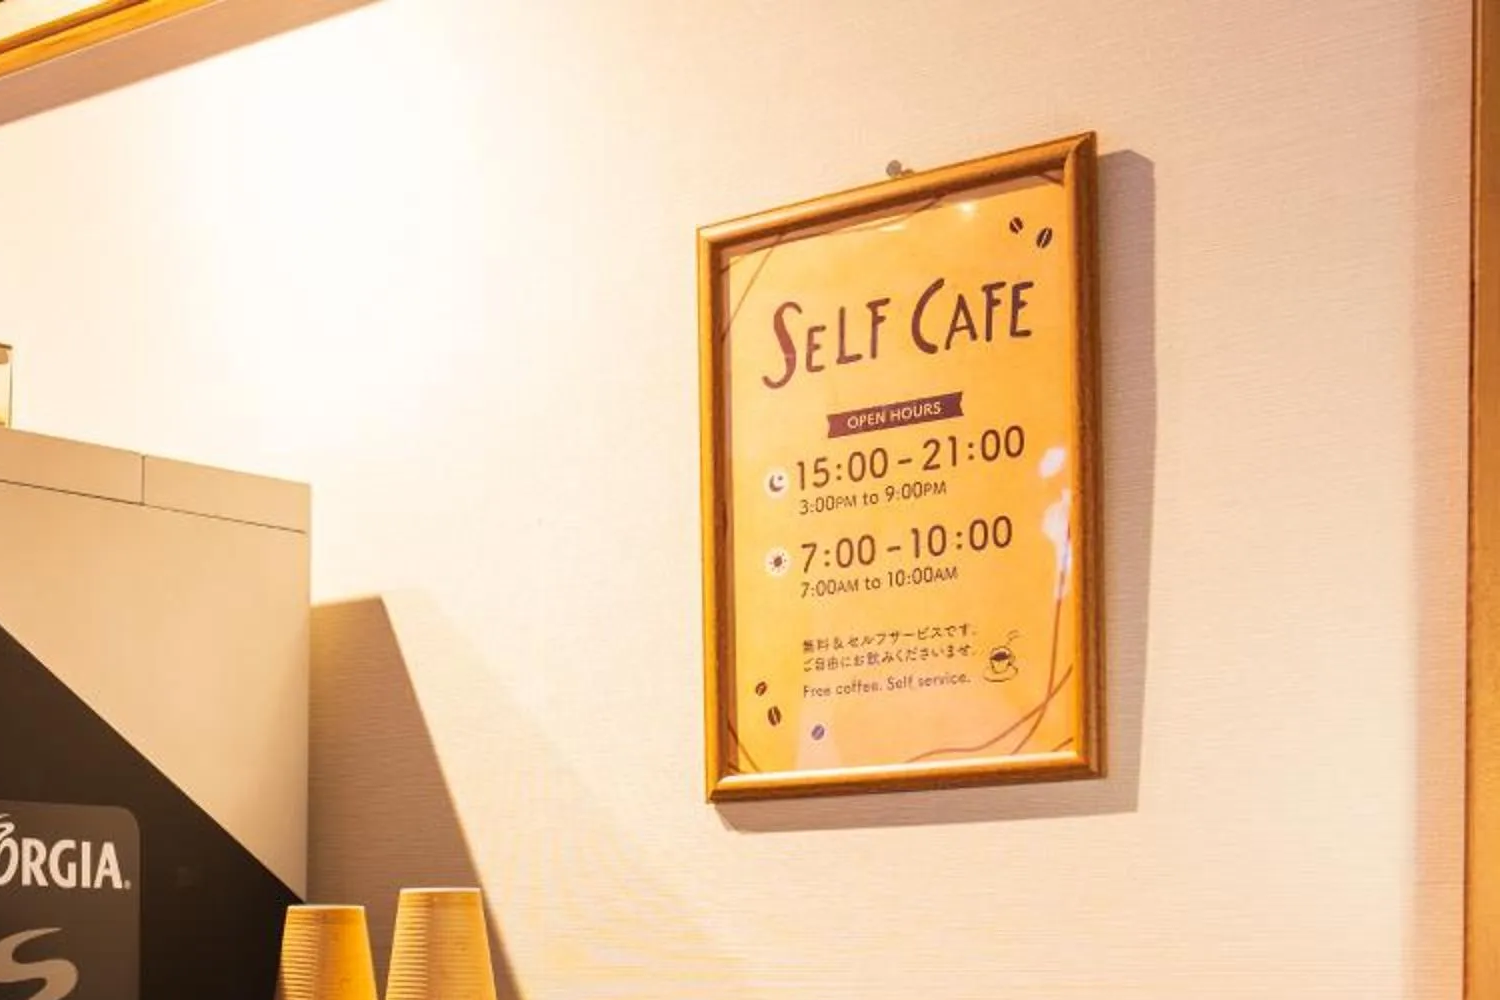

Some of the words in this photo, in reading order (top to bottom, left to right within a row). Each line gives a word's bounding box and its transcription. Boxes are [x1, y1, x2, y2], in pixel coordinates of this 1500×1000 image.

[762, 298, 891, 389] SELF
[911, 277, 1035, 354] CAFE
[847, 412, 886, 430] OPEN
[891, 401, 942, 422] HOURS
[799, 494, 858, 516] 3:00PM
[863, 491, 879, 507] to
[885, 481, 947, 502] 9:00PM
[800, 578, 859, 599] 7:00AM
[865, 575, 881, 591] to
[887, 566, 959, 588] 10:00AM
[803, 684, 831, 698] Free
[887, 675, 913, 691] Self
